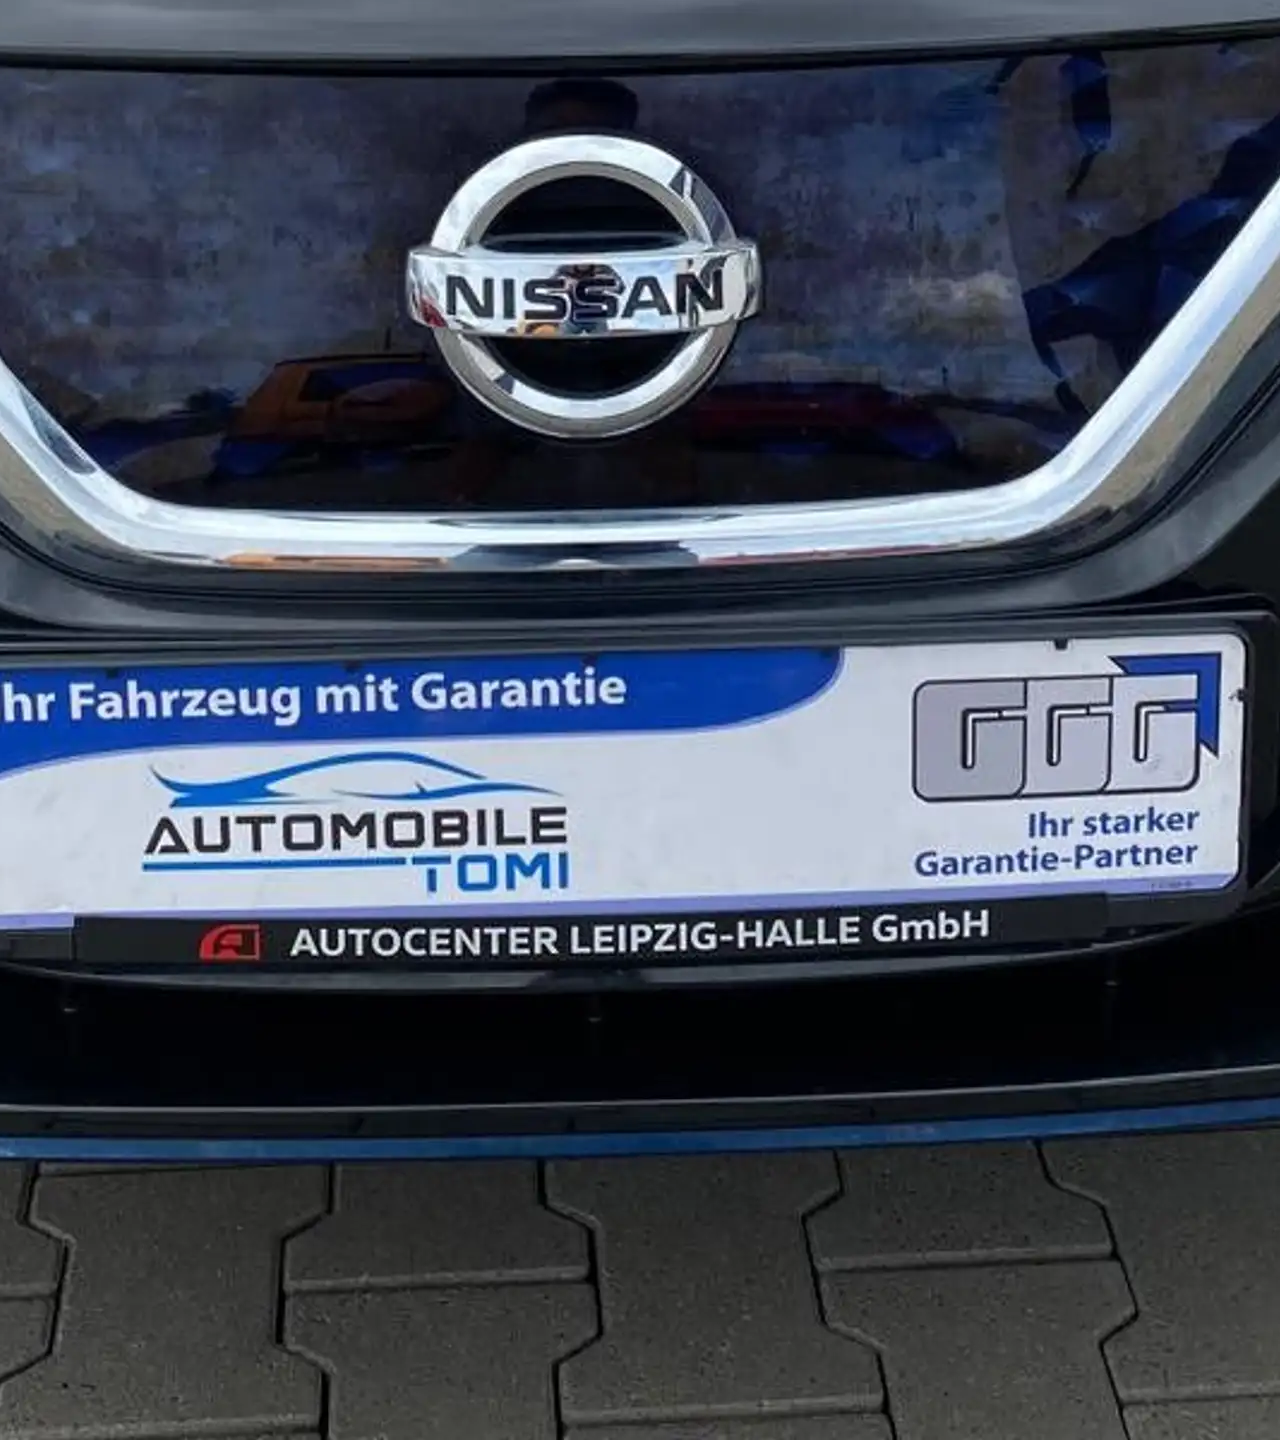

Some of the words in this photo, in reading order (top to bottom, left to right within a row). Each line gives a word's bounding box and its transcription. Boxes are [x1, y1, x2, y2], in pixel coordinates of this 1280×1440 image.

[446, 271, 724, 321] NISSAN
[69, 679, 302, 727] Fahrzeug
[316, 673, 400, 714] mit
[411, 666, 628, 711] Garantie
[144, 806, 568, 855] AUTOMOBILE
[1028, 812, 1075, 838] Ihr
[1083, 806, 1201, 837] starker
[411, 851, 569, 893] TOMI
[914, 842, 1199, 877] Garantie-Partner
[289, 927, 559, 957] AUTOCENTER
[569, 917, 861, 955] LEIPZIG-HALLE
[871, 909, 991, 944] GmbH
